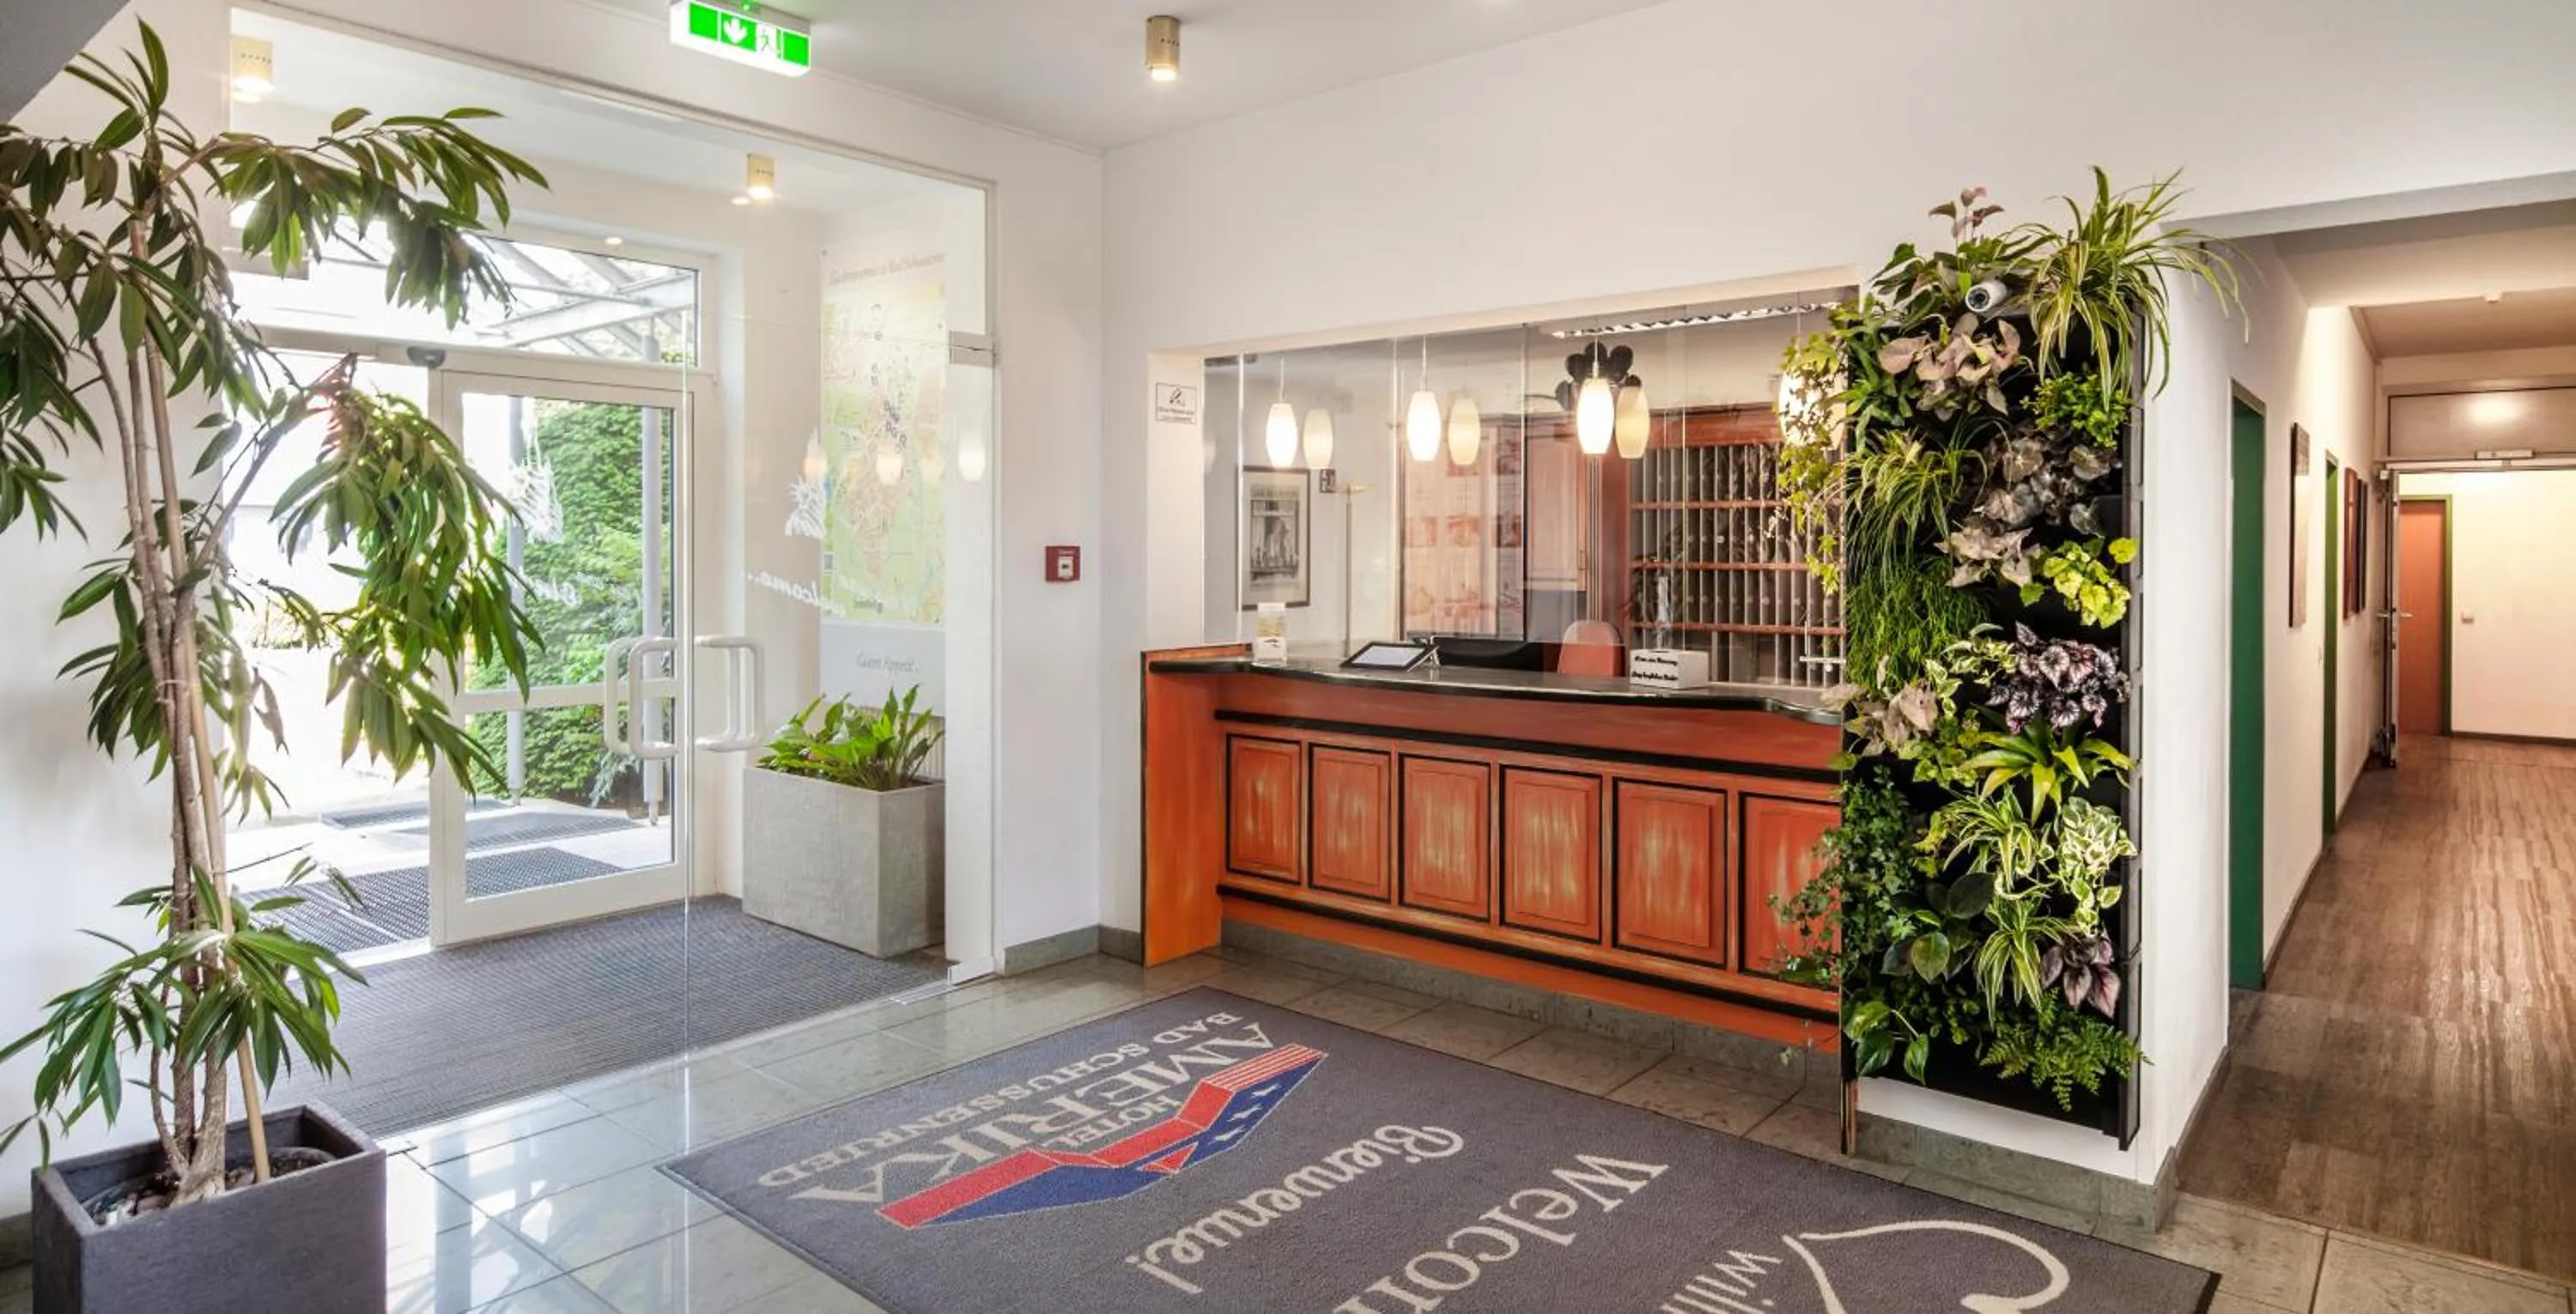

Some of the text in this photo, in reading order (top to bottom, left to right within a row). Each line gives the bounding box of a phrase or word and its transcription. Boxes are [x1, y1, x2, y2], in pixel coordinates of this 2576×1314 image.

[756, 1011, 1243, 1189] BAD SCHUSSENRIED
[787, 1021, 1277, 1203] AMERIKA
[1042, 1094, 1184, 1147] HOTEL
[1124, 1123, 1465, 1296] Bienvenue!
